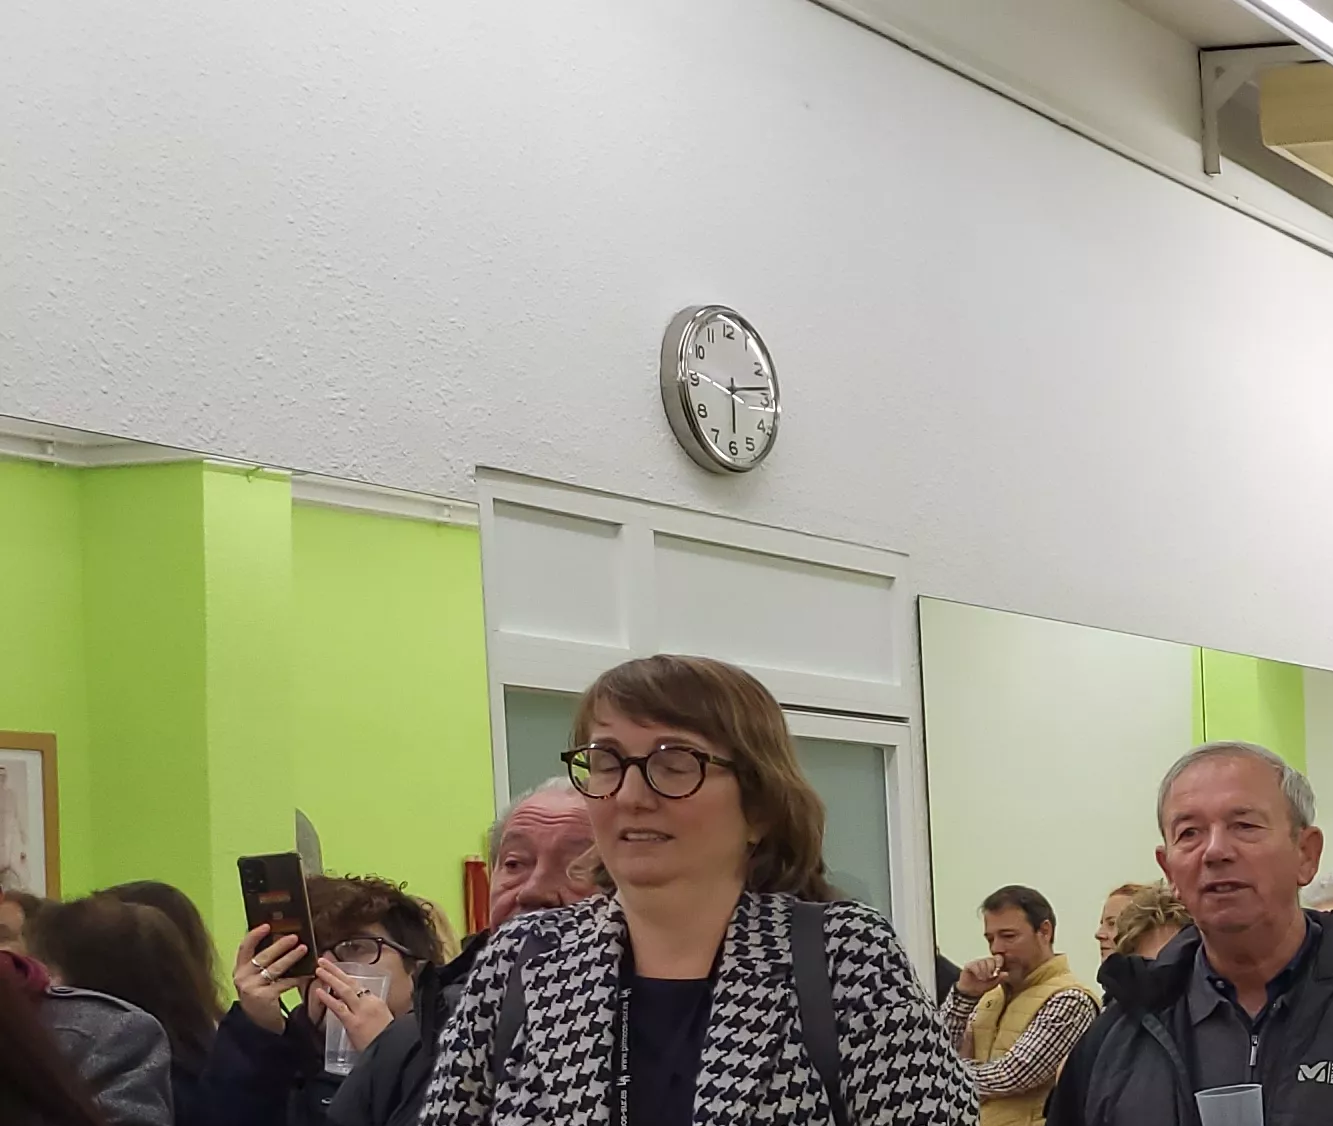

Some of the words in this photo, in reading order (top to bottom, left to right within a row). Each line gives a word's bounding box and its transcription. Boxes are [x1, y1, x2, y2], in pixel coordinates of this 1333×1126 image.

[707, 327, 715, 344] 11
[722, 323, 735, 340] 12
[695, 344, 705, 360] 10
[753, 361, 763, 377] 2
[690, 372, 699, 387] 9
[697, 403, 708, 419] 8
[757, 418, 766, 434] 4
[710, 428, 720, 444] 7
[728, 440, 738, 456] 6
[745, 437, 755, 452] 5
